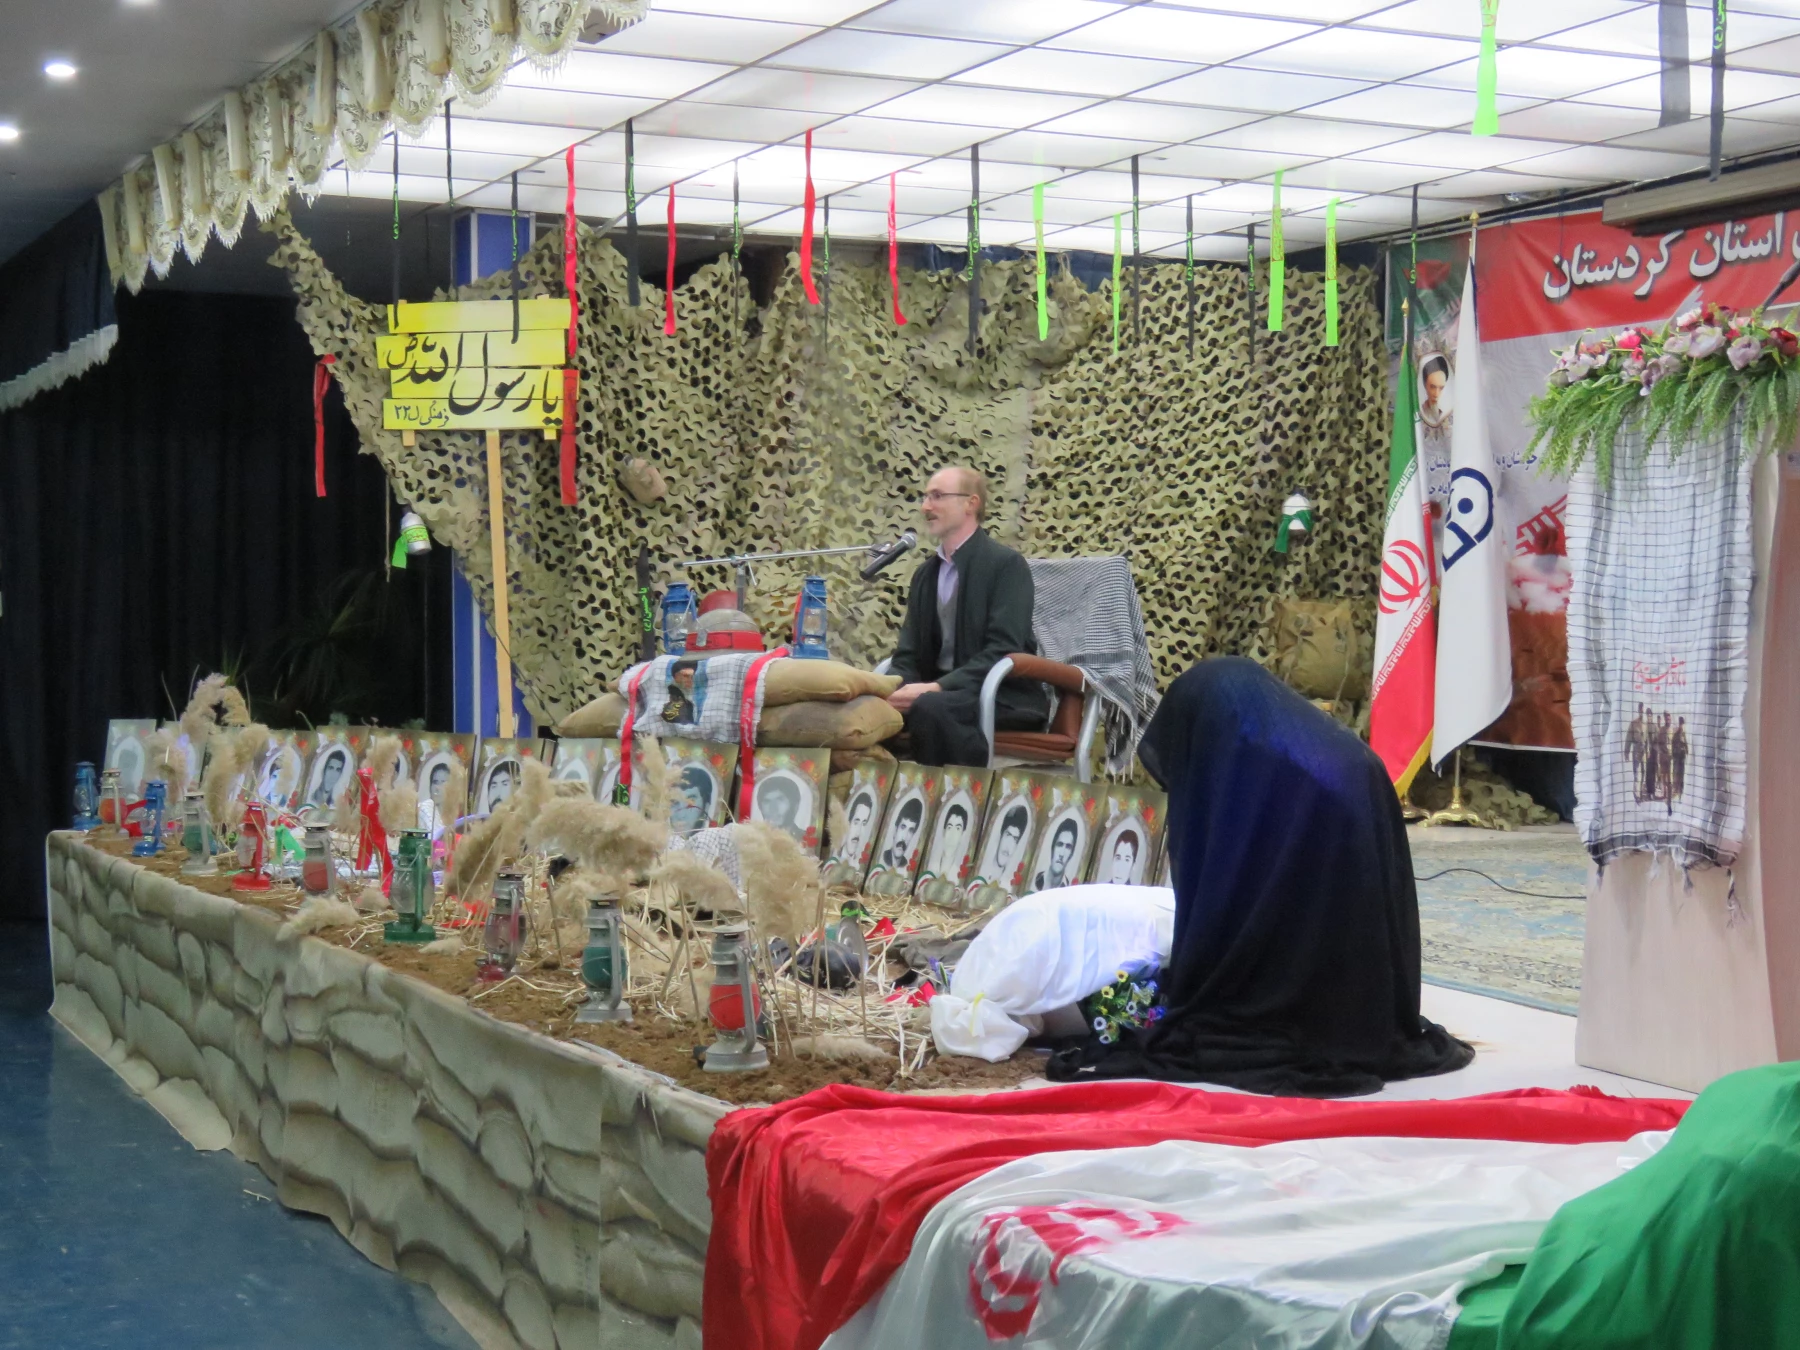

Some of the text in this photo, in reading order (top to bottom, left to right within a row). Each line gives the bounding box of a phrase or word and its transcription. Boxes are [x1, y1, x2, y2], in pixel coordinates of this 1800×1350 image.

[1543, 229, 1685, 298] کردستان
[1690, 211, 1784, 277] استان
[392, 333, 464, 385] الله
[448, 332, 536, 416] رسول
[542, 371, 563, 427] یا
